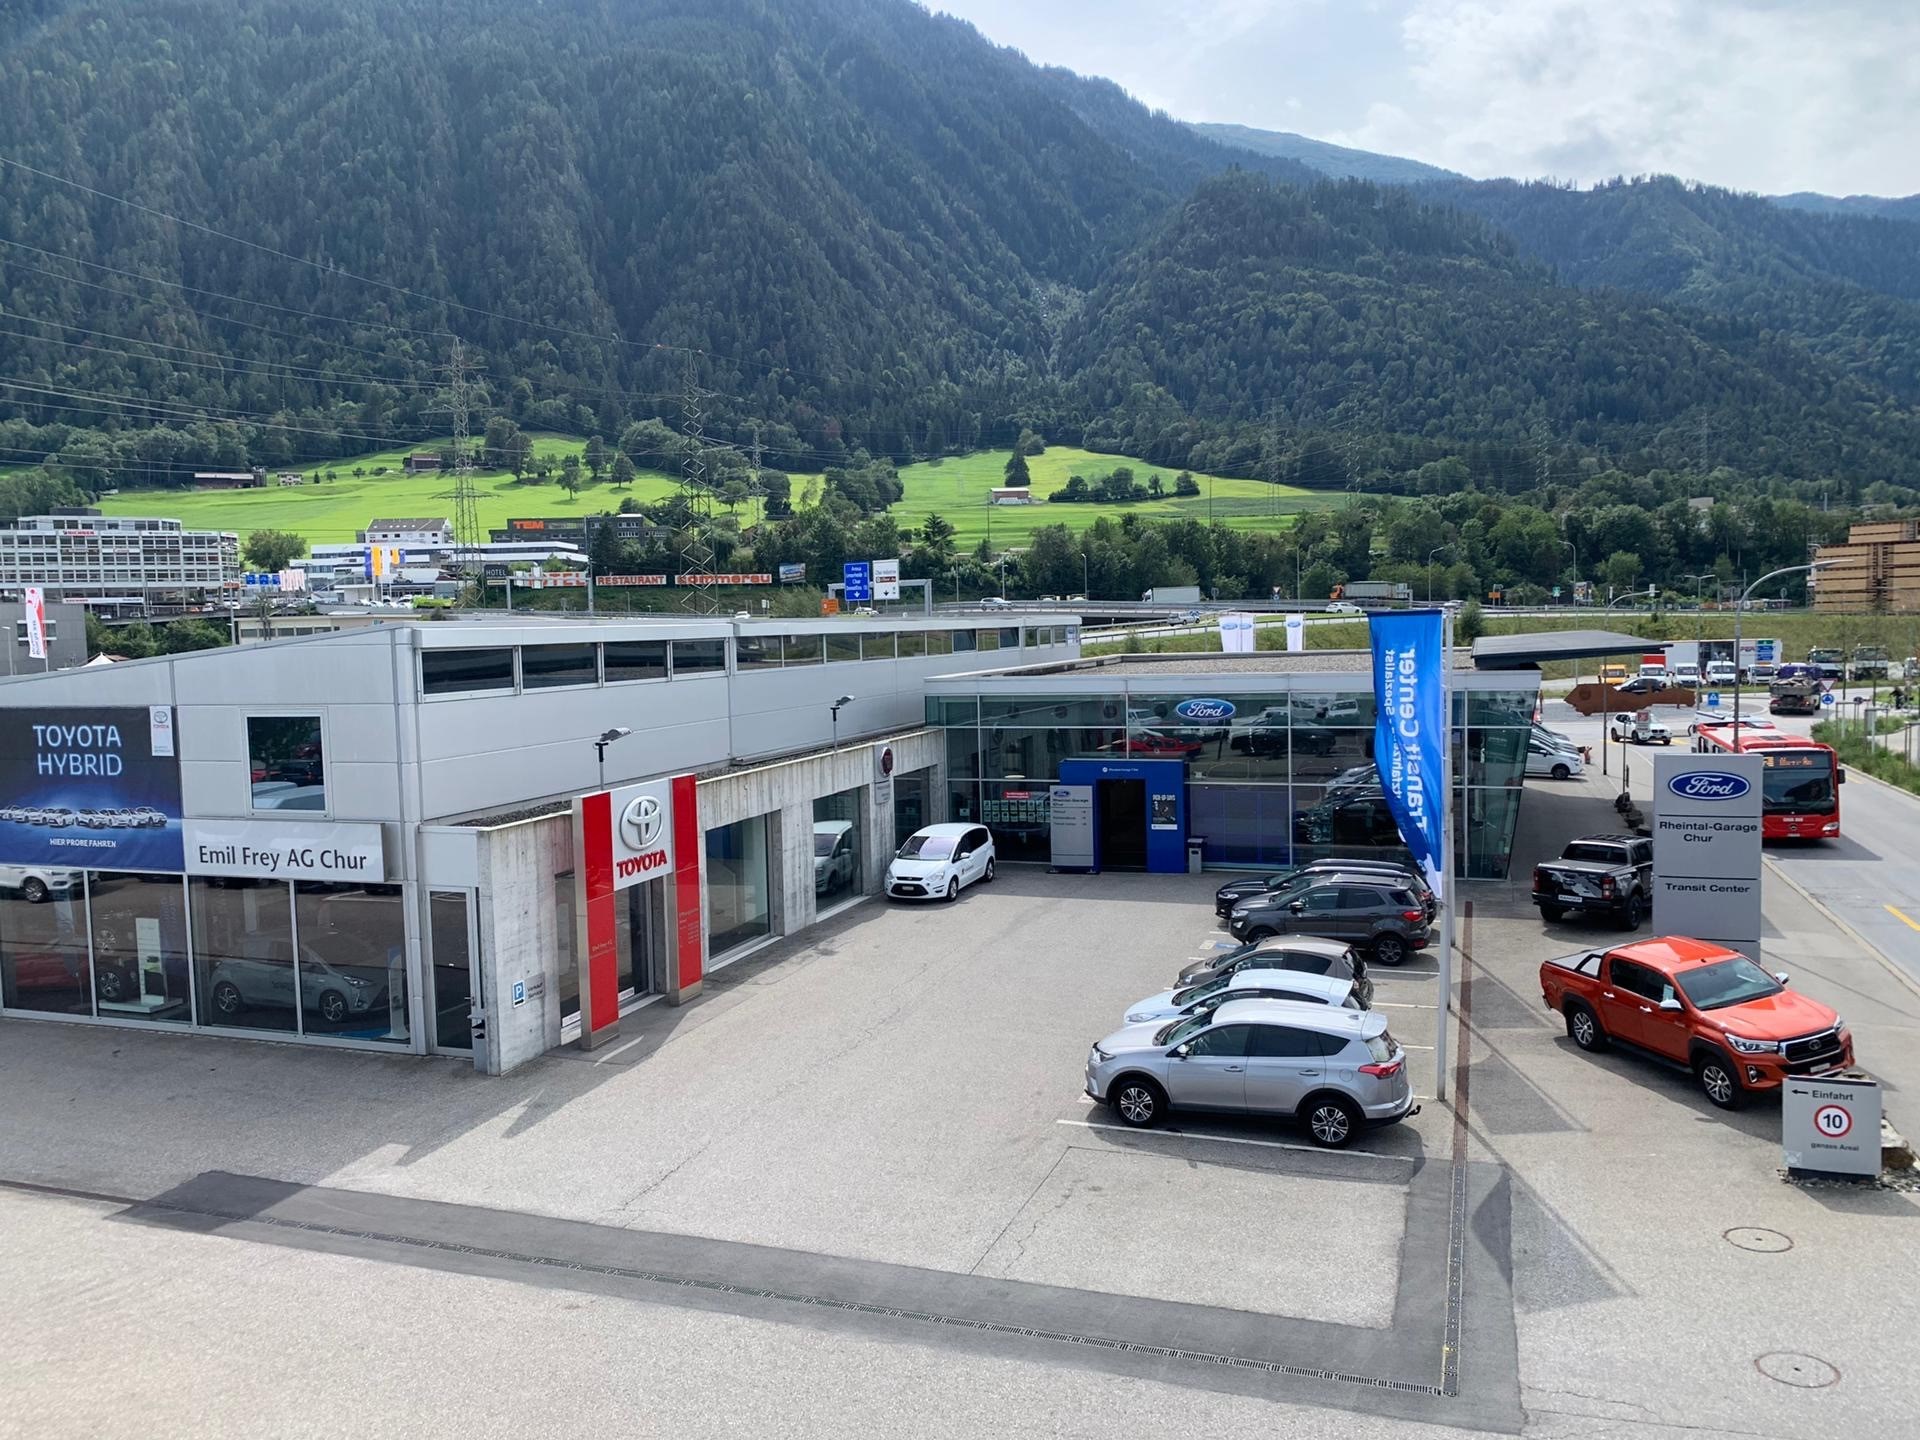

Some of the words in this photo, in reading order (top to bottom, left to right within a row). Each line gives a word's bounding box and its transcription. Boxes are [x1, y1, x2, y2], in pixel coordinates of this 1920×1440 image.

[598, 576, 664, 585] RESTAURANT
[1187, 701, 1223, 717] Ford
[32, 725, 122, 747] TOYOTA
[37, 753, 122, 776] HYBRID
[1685, 776, 1735, 795] Ford
[1659, 821, 1758, 833] Rheintal-Garage
[50, 838, 66, 846] HIER
[67, 838, 88, 847] PROBE
[89, 839, 116, 848] FAHREN
[1683, 833, 1713, 843] Chur
[199, 845, 236, 864] Emil
[242, 847, 280, 872] Frey
[287, 849, 314, 868] AG
[320, 849, 367, 870] Chur
[616, 849, 668, 878] TOYOTA
[1665, 882, 1706, 892] Transit
[1709, 884, 1750, 893] Center
[515, 985, 523, 998] P
[1812, 1090, 1854, 1101] Einfahrt
[1823, 1113, 1843, 1129] 10
